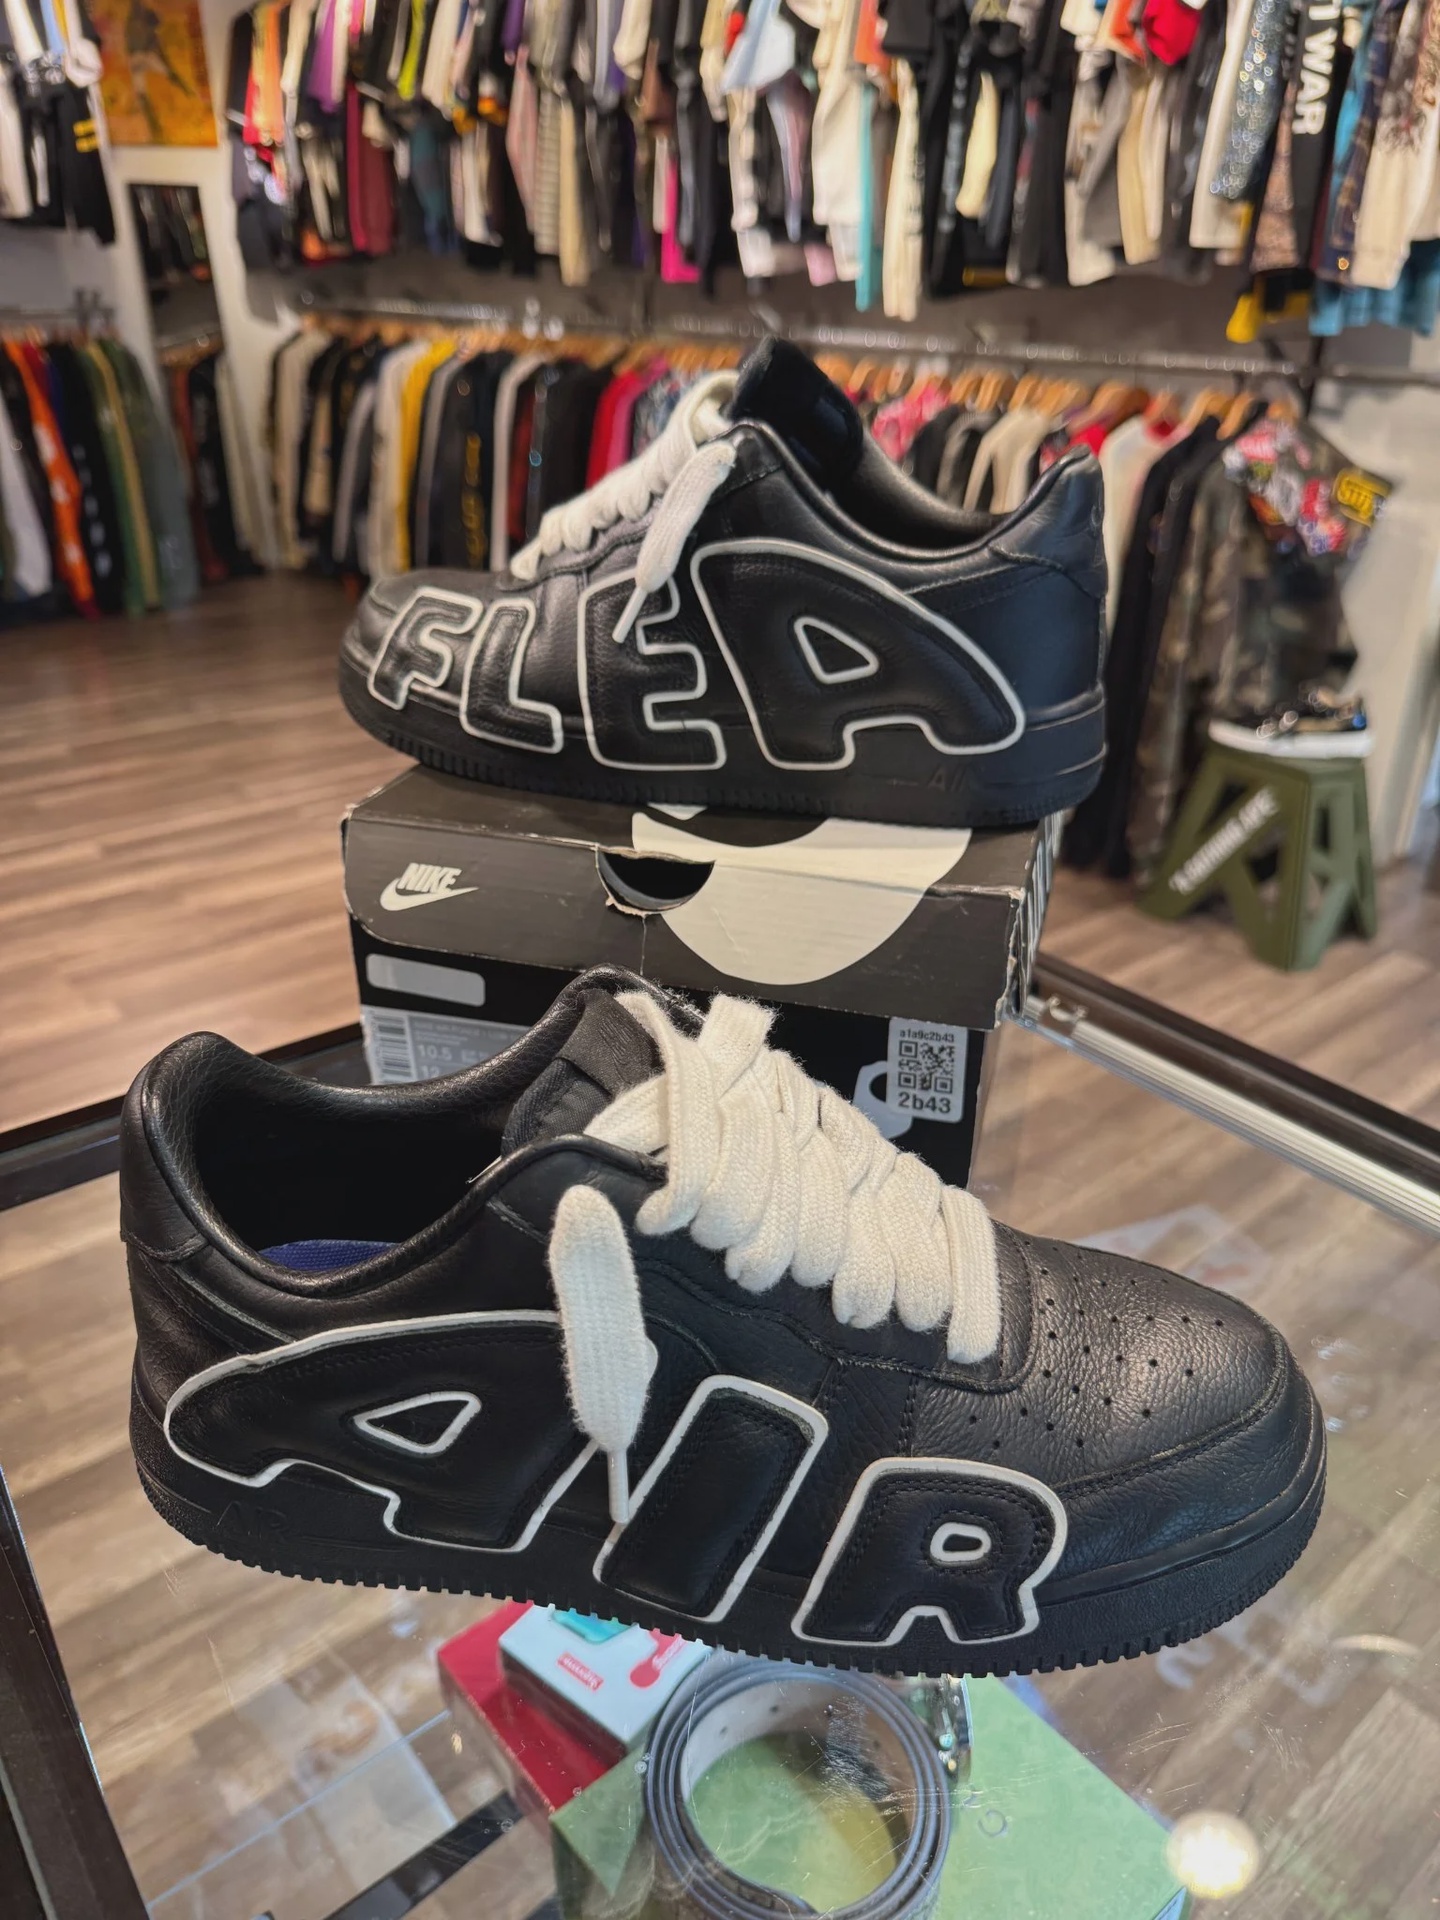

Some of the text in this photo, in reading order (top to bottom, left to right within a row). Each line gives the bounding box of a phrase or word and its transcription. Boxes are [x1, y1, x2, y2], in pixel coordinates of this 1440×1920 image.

[1291, 27, 1338, 135] WAR
[396, 862, 462, 894] NIKE
[899, 1028, 955, 1043] a1a9c2b43
[898, 1091, 951, 1114] 2b43
[163, 1310, 1069, 1647] AIR
